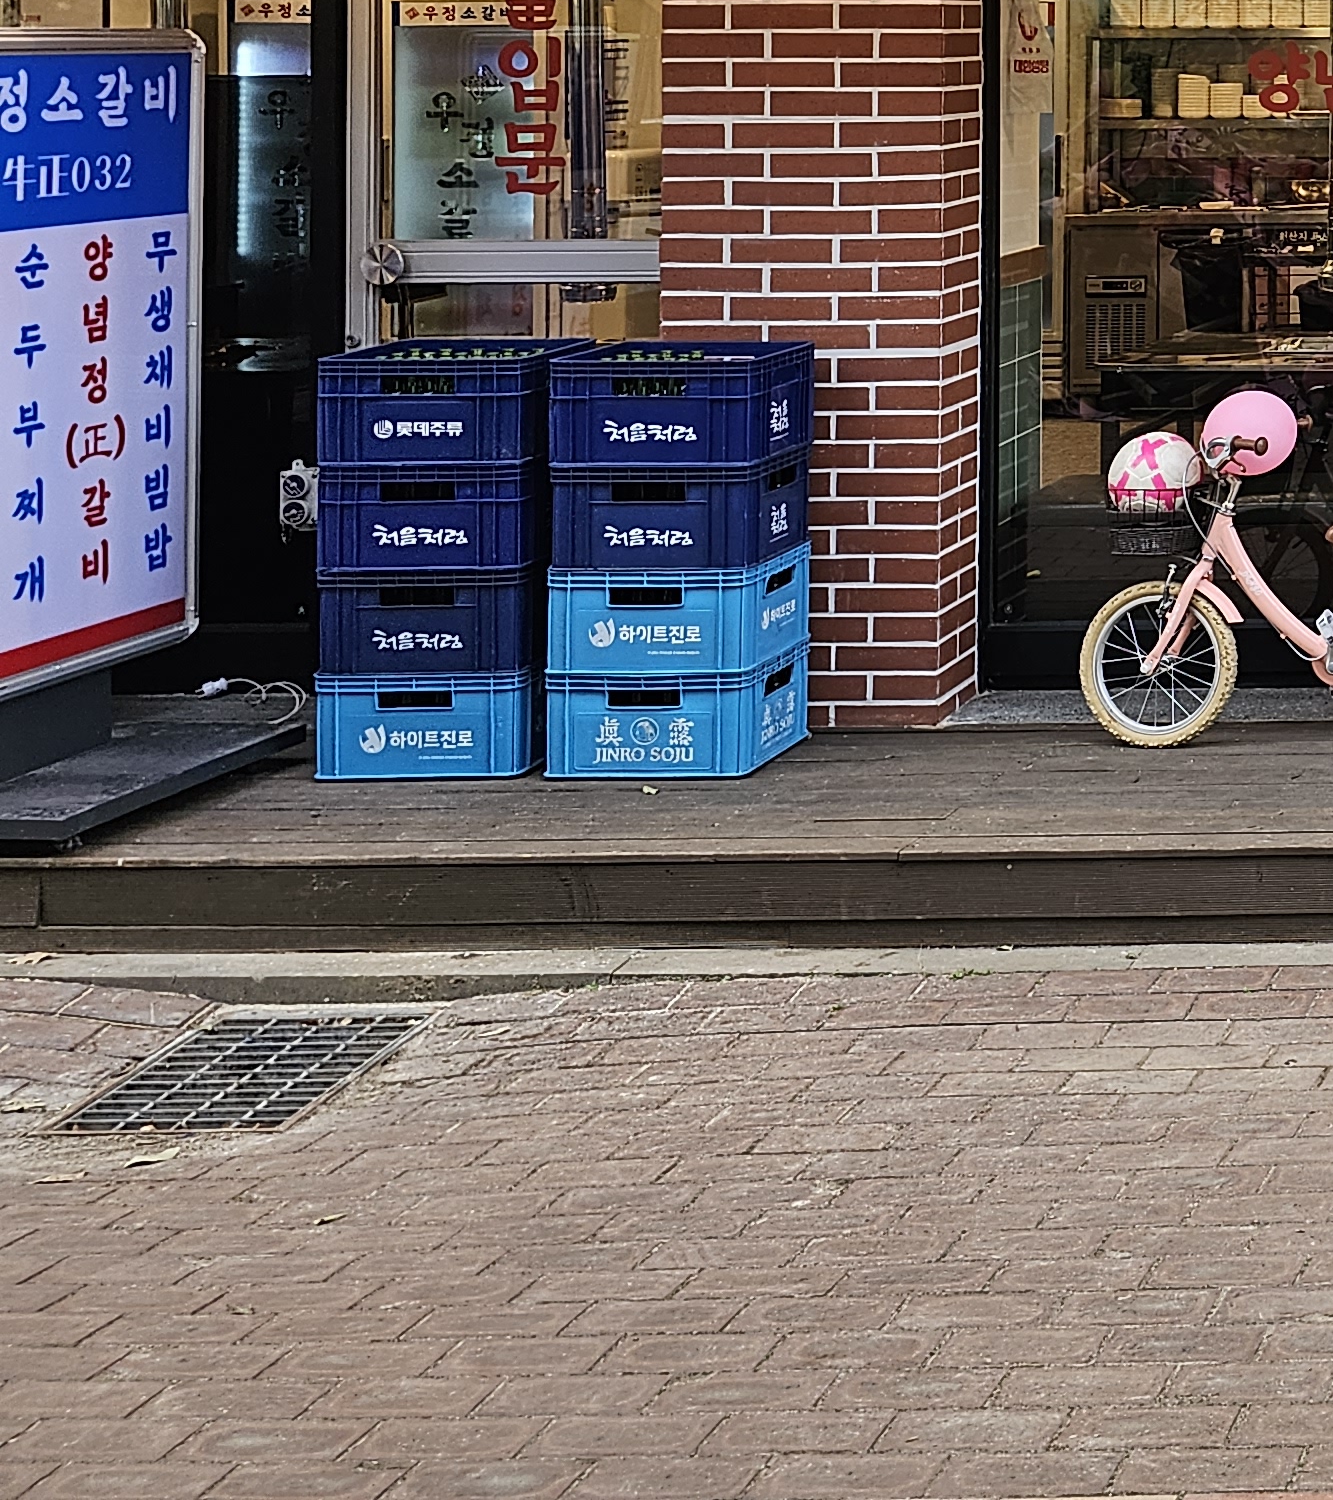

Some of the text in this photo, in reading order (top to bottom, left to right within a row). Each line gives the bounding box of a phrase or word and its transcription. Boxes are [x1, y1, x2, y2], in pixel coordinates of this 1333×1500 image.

[2, 153, 133, 202] 牛正032
[65, 233, 127, 586] 양념정(正)갈비
[142, 230, 178, 573] 무생채비빔밥
[11, 242, 51, 604] 순두부찌개
[396, 421, 464, 438] 롯데주류
[603, 419, 698, 443] 처음처럼
[371, 524, 469, 547] 처음처럼
[603, 525, 694, 548] 처음처럼
[371, 629, 464, 651] 처음처럼
[618, 625, 702, 645] 하이트진로
[389, 729, 475, 750] 하이트진로
[592, 746, 695, 765] JINRO SOJU
